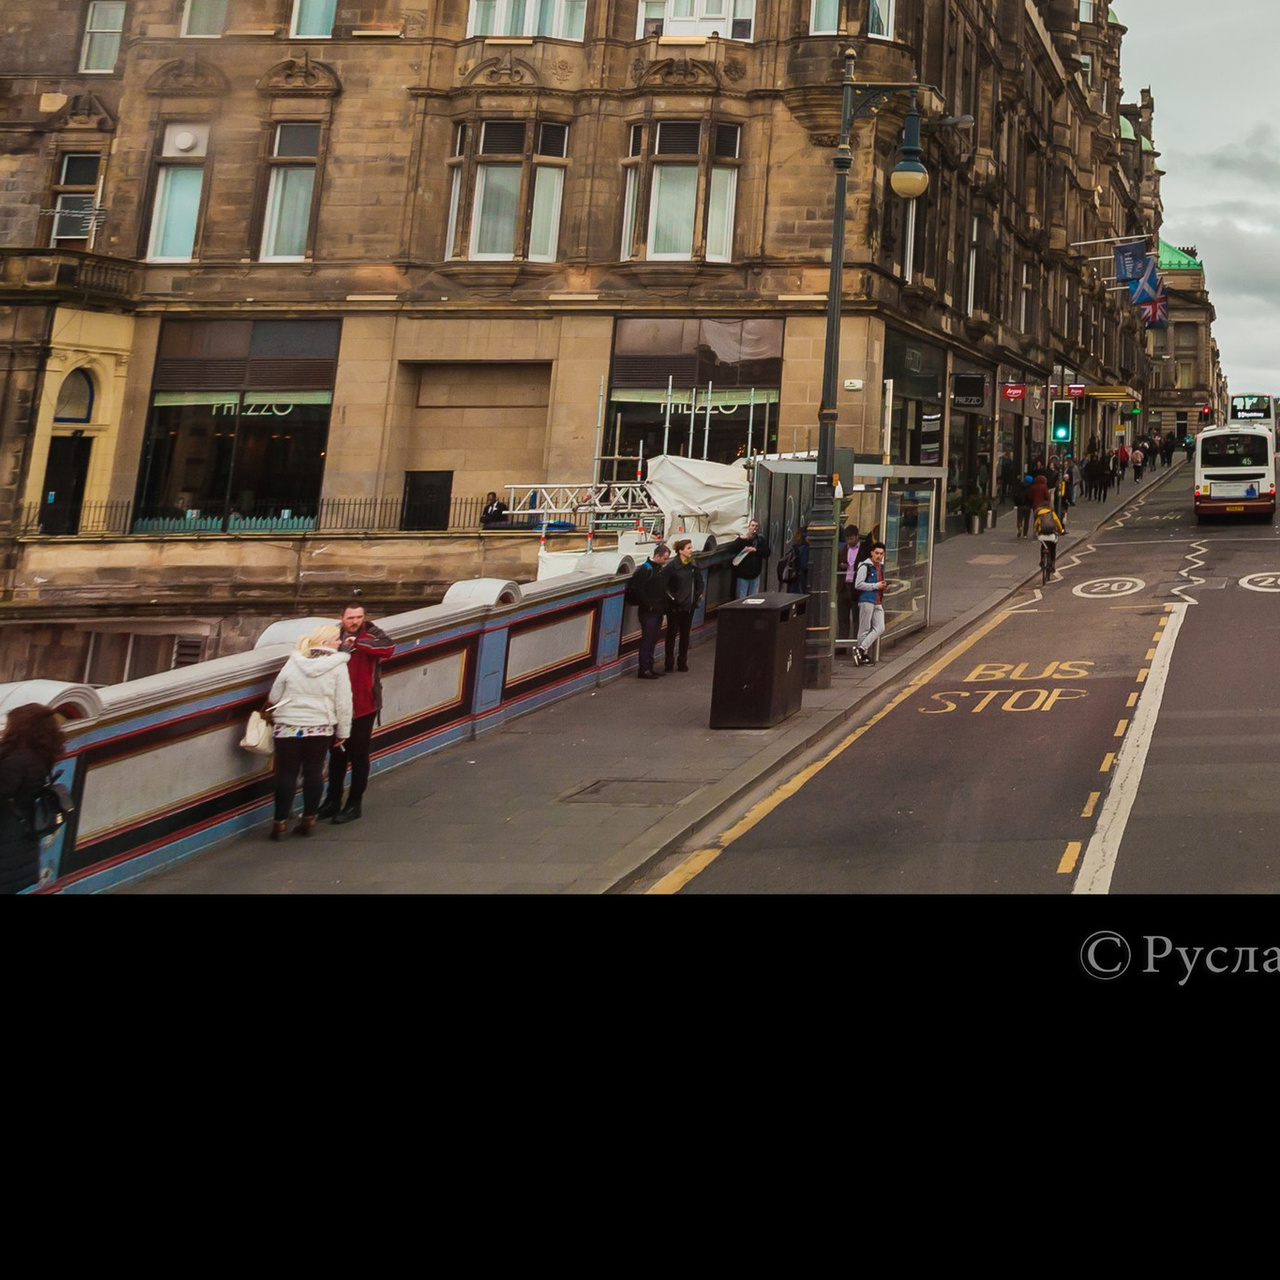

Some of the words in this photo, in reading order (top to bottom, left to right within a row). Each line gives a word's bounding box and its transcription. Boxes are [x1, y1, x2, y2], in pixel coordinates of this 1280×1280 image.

[1006, 388, 1022, 397] Argos
[955, 396, 982, 405] PREZZO
[1091, 581, 1133, 593] 20
[963, 661, 1095, 682] BUS
[918, 688, 1089, 713] STOP
